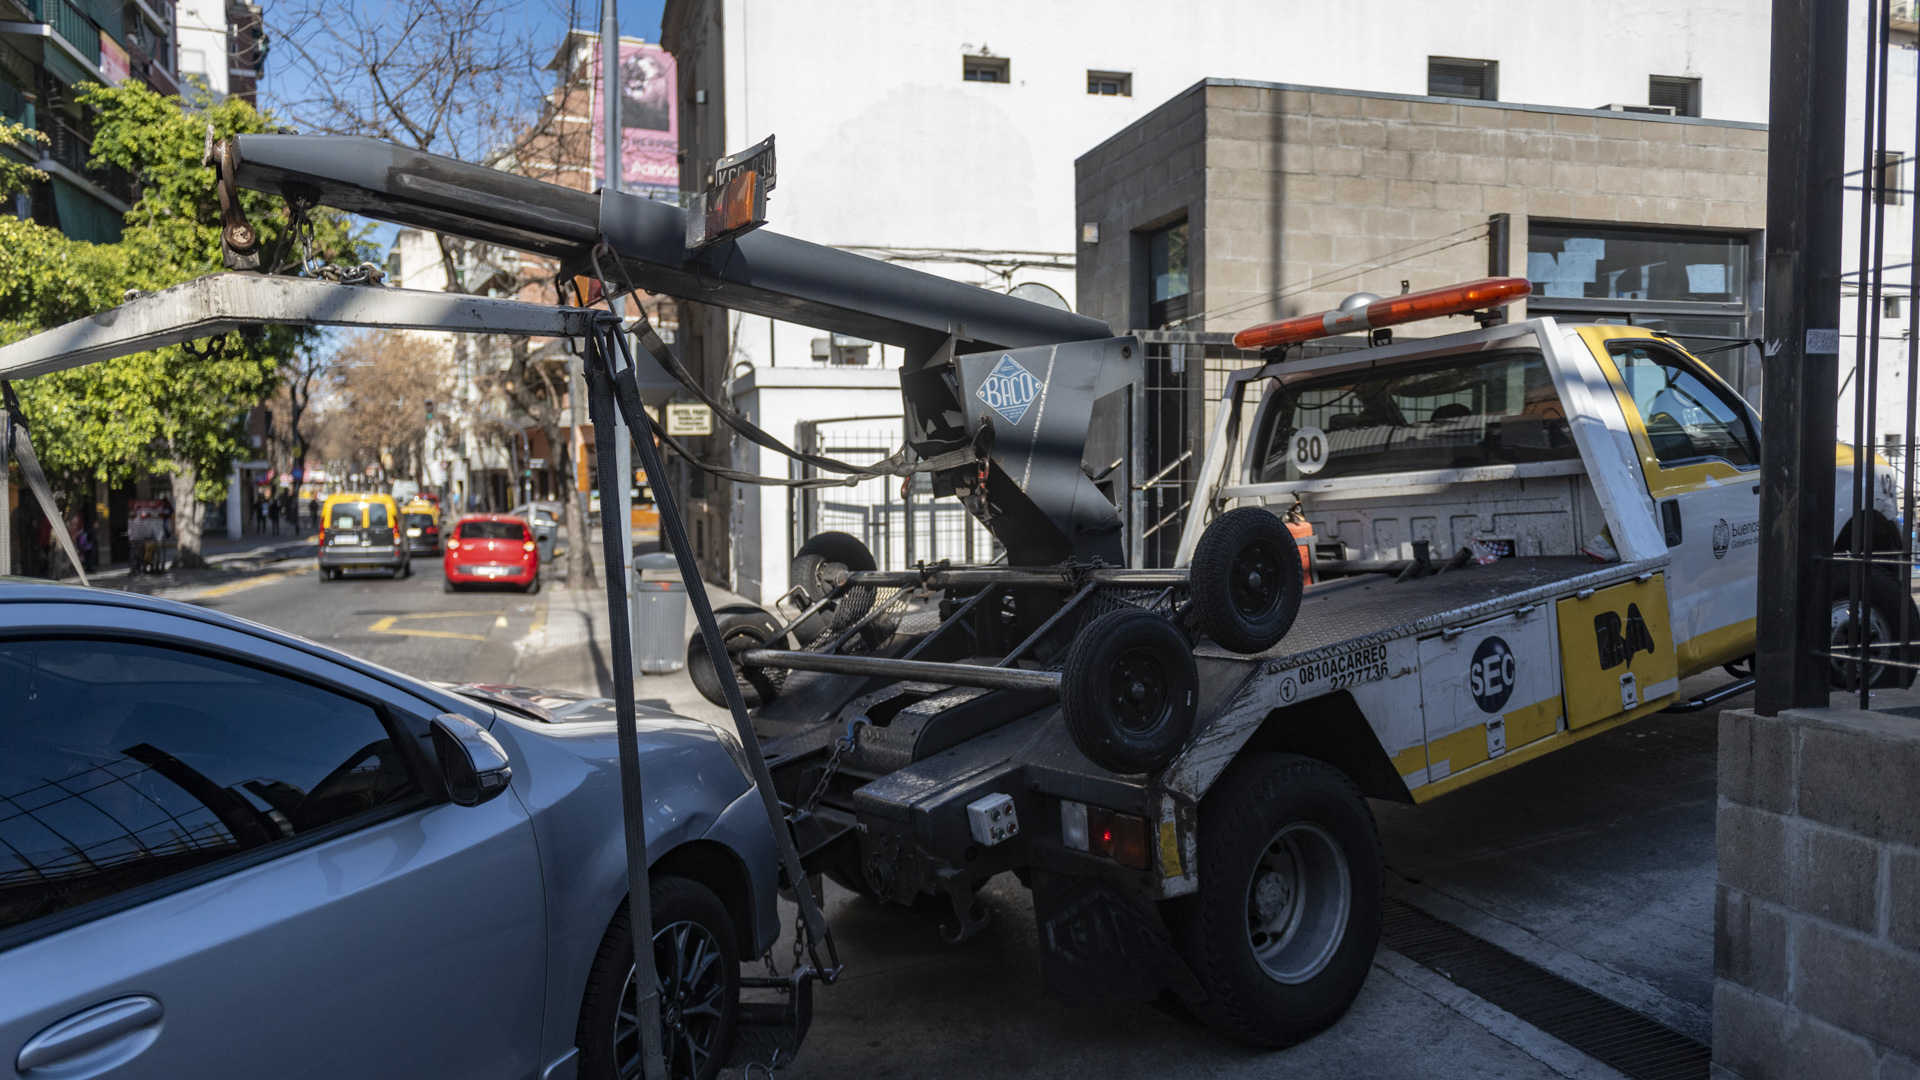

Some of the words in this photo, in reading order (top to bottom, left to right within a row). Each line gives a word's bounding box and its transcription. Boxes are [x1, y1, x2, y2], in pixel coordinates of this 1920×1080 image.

[985, 373, 1034, 408] BACO
[1297, 436, 1321, 463] 80
[1731, 521, 1759, 537] buenos
[1471, 653, 1515, 697] SEC
